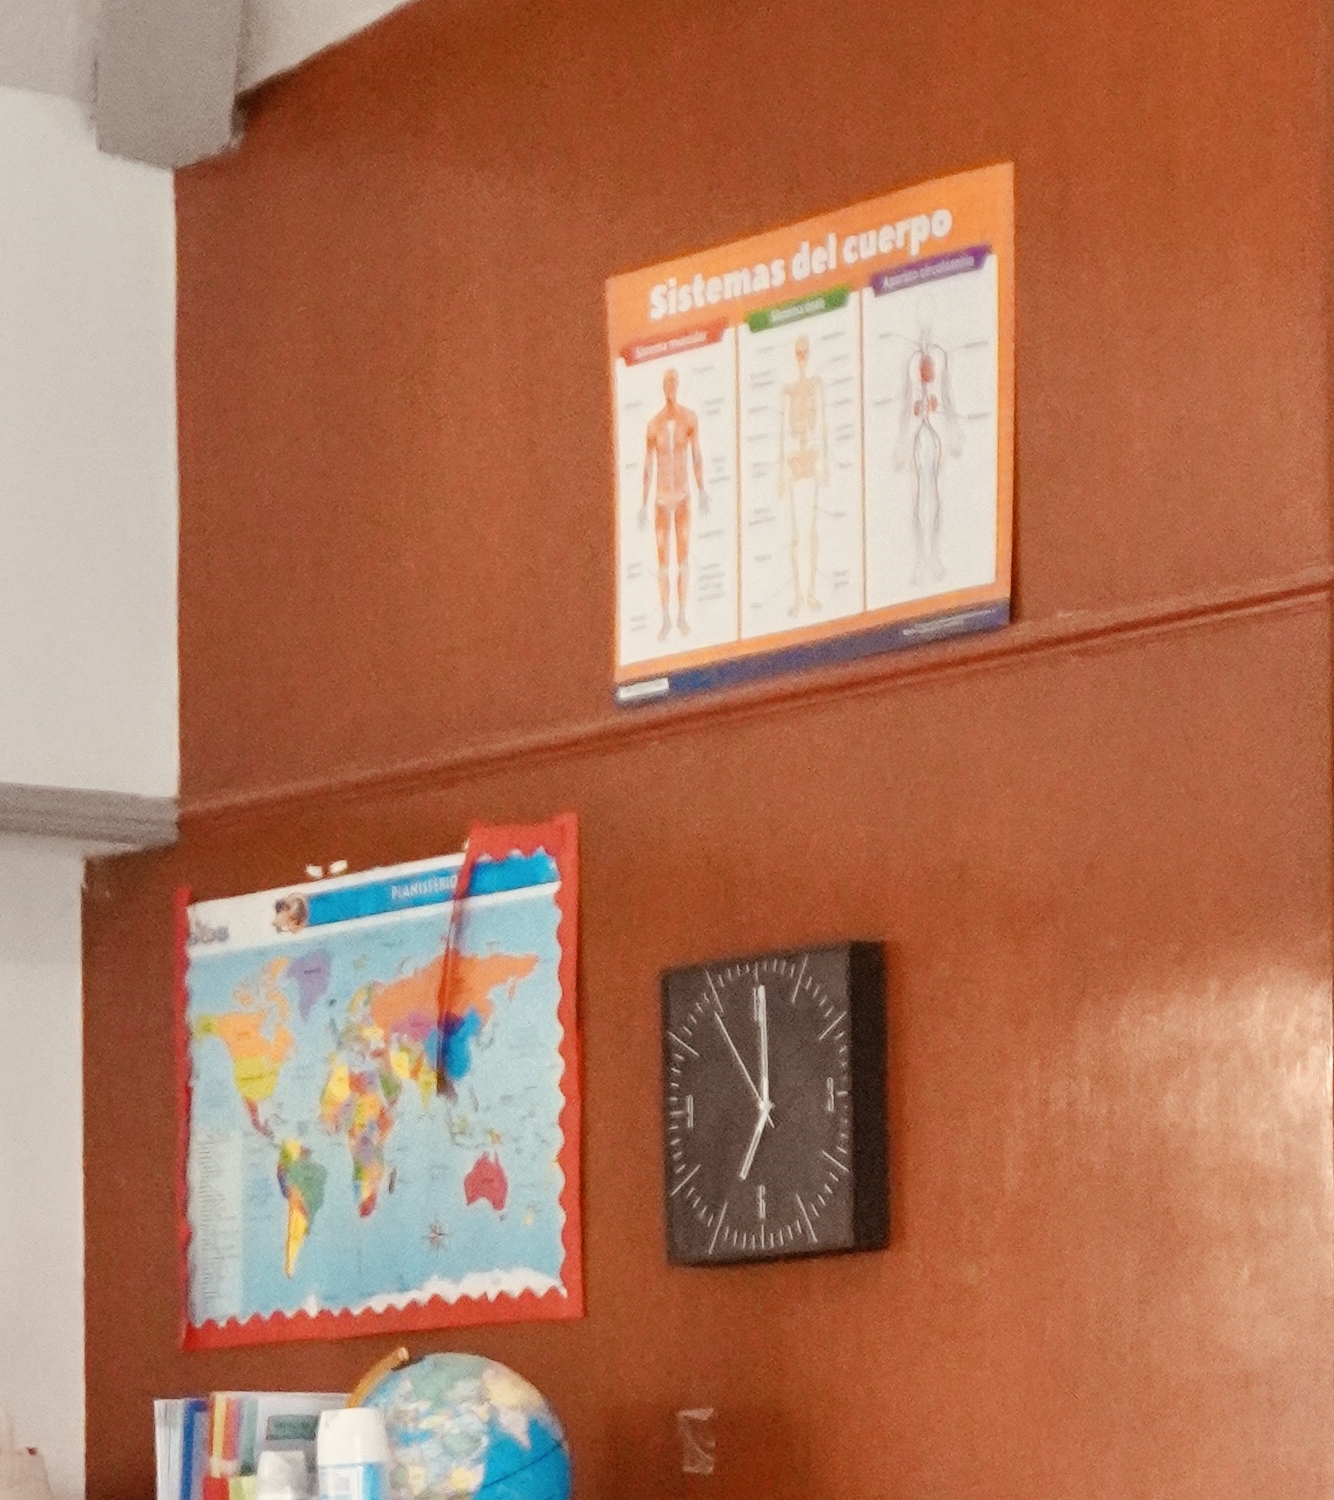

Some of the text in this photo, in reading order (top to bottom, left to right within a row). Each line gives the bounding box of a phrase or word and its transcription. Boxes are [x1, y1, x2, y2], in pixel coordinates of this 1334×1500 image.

[648, 257, 785, 320] Sistemas
[791, 232, 837, 281] del
[842, 208, 953, 264] cuerpo
